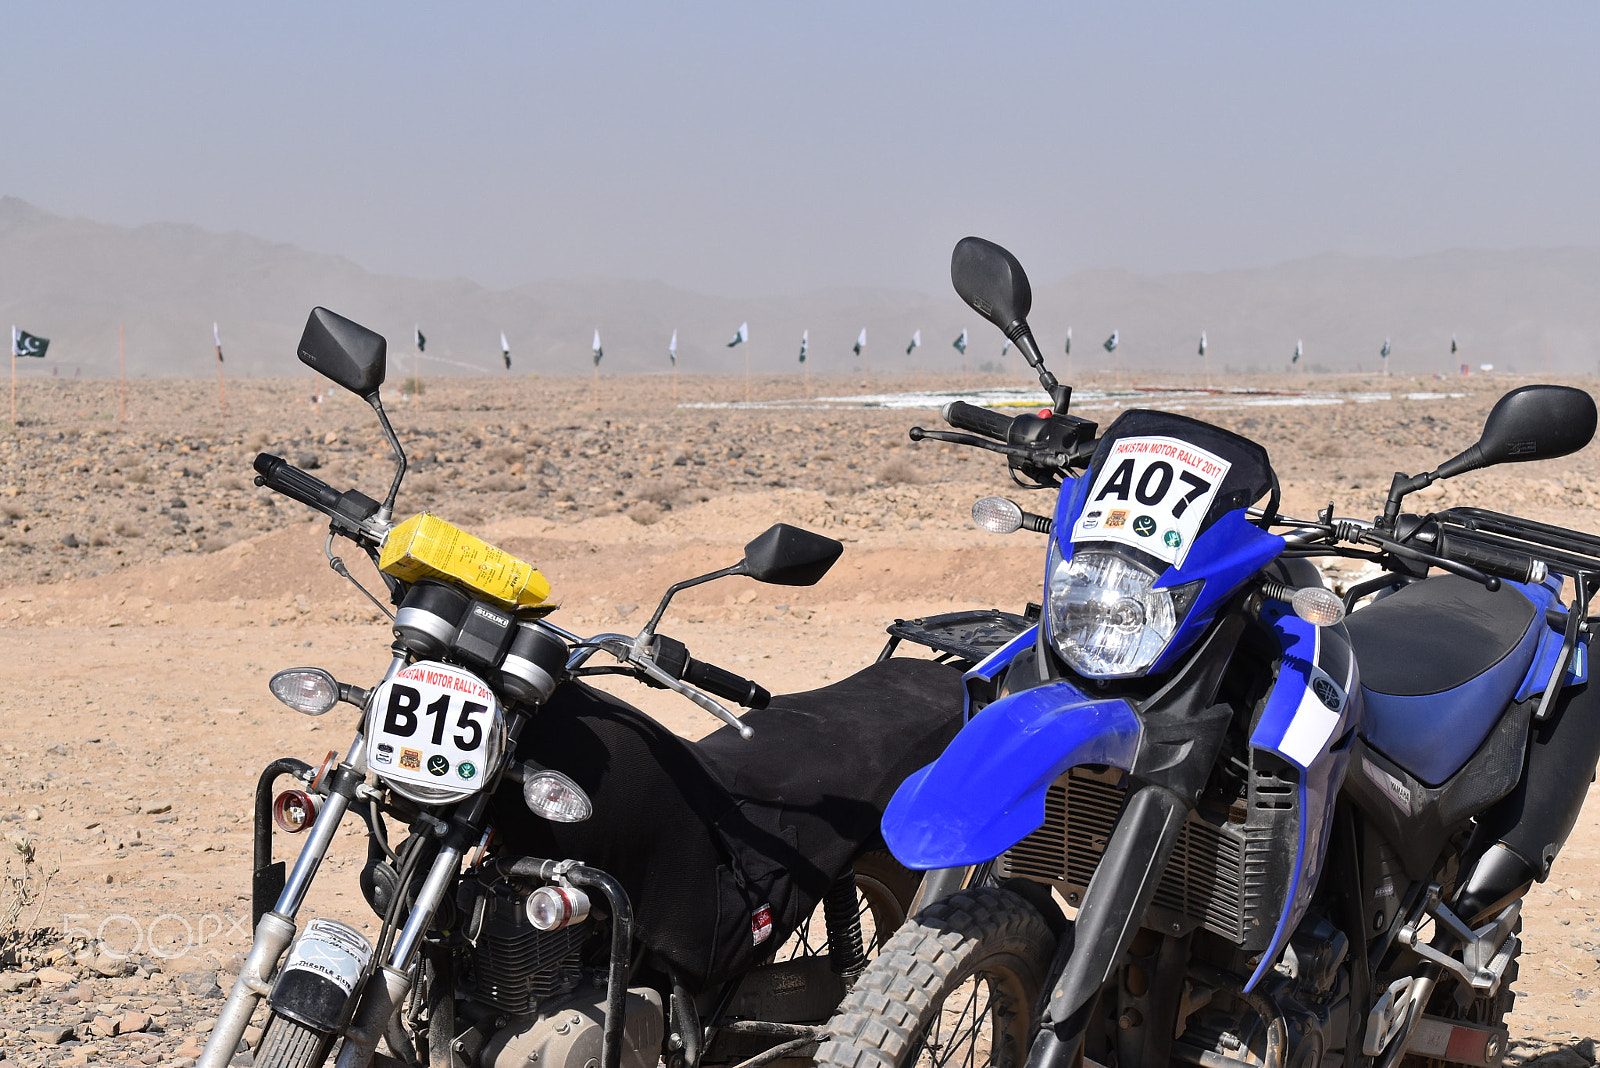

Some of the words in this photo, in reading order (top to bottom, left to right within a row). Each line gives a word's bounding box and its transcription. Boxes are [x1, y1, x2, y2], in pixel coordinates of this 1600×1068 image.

[1115, 443, 1150, 455] PAKISTAN
[1149, 443, 1178, 458] MOTOR
[1176, 449, 1203, 468] RALLY
[1201, 461, 1222, 478] 2017
[1094, 458, 1212, 520] A07
[475, 607, 508, 627] SUZUKI
[425, 671, 453, 689] MOTOR
[453, 678, 477, 695] RALLY
[477, 686, 493, 702] 2017
[383, 683, 488, 752] B15
